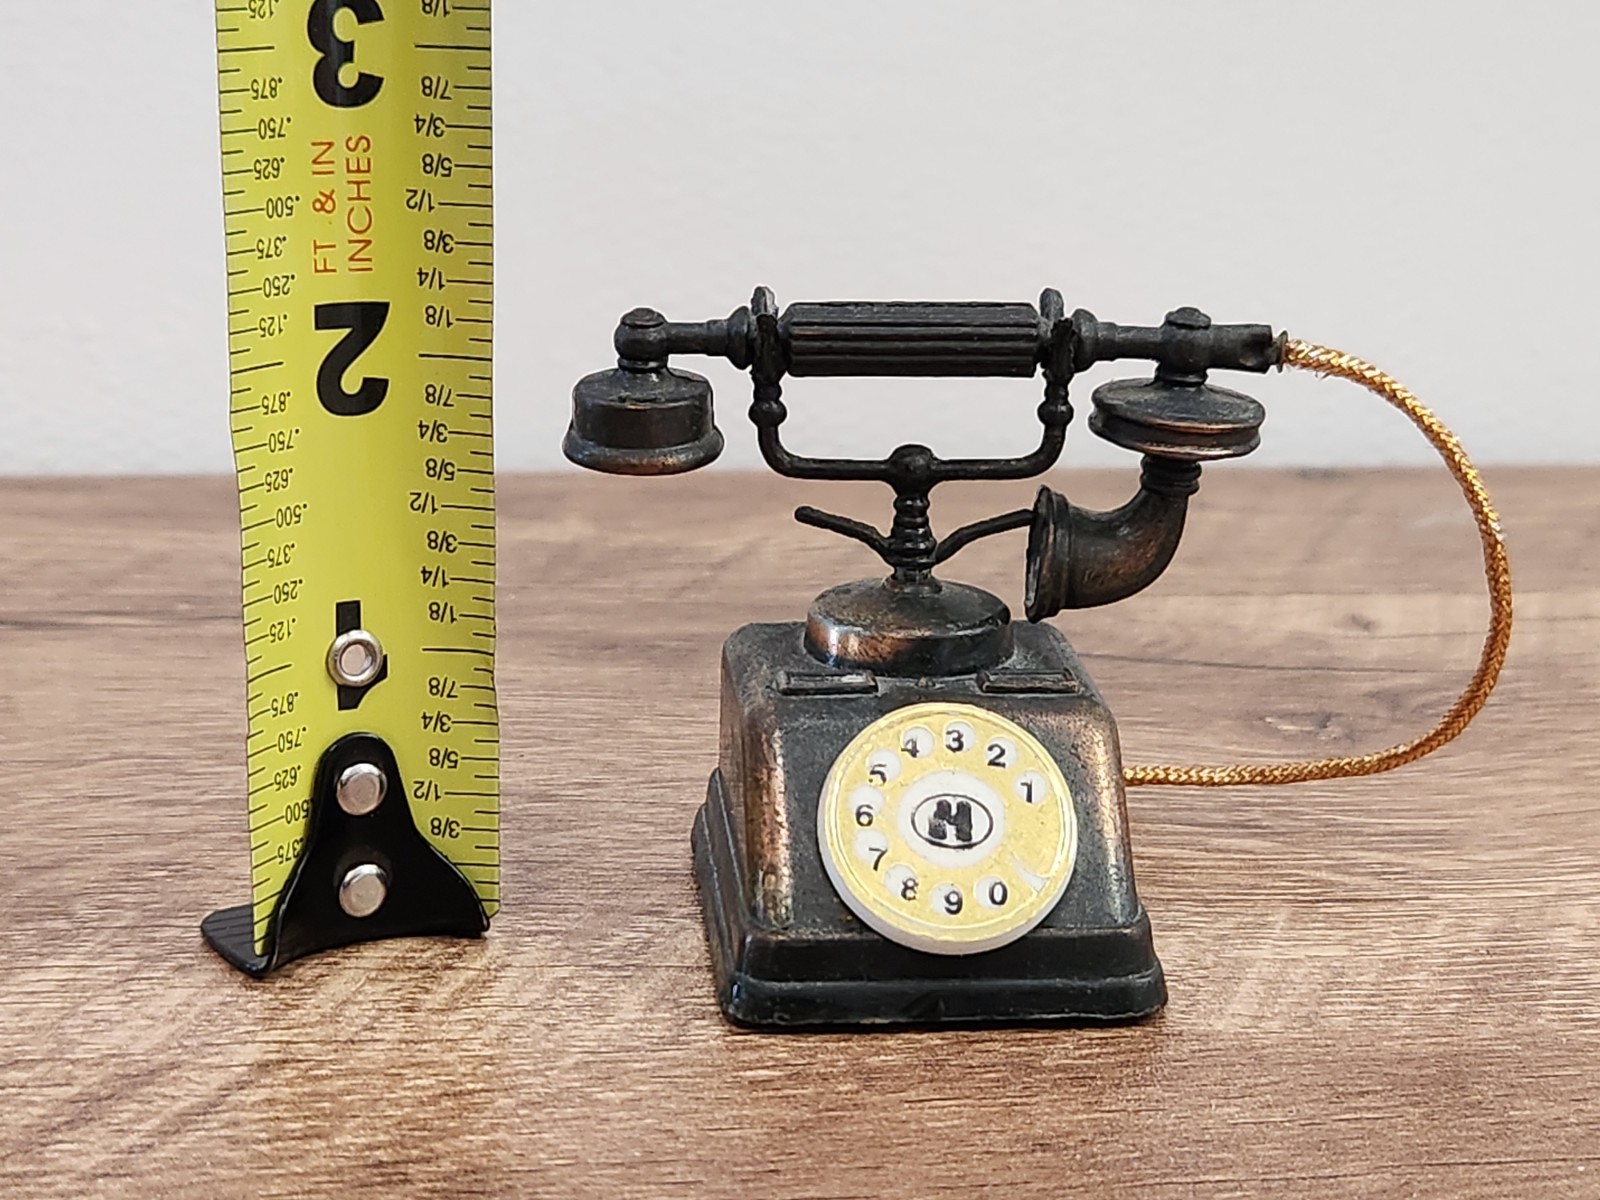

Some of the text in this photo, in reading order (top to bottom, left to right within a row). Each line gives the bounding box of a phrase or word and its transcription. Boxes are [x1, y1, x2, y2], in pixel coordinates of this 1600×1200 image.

[307, 0, 385, 108] 3
[251, 77, 282, 100] .875
[421, 76, 452, 100] 7/8
[258, 117, 291, 139] .750
[414, 114, 445, 137] 3/4
[254, 158, 285, 180] .625
[422, 153, 452, 177] 5/8
[266, 196, 300, 219] .500
[311, 141, 337, 273] FT & IN
[346, 135, 373, 272] INCHES
[405, 189, 434, 212] 1/2
[257, 236, 287, 259] .375
[424, 230, 454, 254] 3/8
[263, 274, 295, 298] .250
[417, 267, 445, 290] 1/4
[259, 314, 287, 337] .125
[425, 305, 453, 328] 1/8
[314, 301, 390, 417] 2
[261, 392, 291, 415] .875
[425, 384, 454, 407] 7/8
[268, 429, 300, 453] .750
[418, 420, 448, 443] 3/4
[265, 468, 293, 493] .625
[425, 458, 455, 481] 5/8
[410, 492, 438, 514] 1/2
[276, 503, 307, 528] .500
[427, 531, 458, 553] 3/8
[267, 543, 295, 568] .375
[421, 566, 449, 587] 1/4
[274, 579, 303, 604] .250
[428, 602, 457, 624] 1/8
[269, 618, 296, 643] .125
[428, 677, 458, 698] 7/8
[271, 692, 299, 718] .875
[421, 711, 451, 733] 3/4
[278, 727, 307, 752] .750
[900, 737, 919, 758] 4
[945, 729, 964, 753] 3
[429, 748, 458, 768] 5/8
[988, 743, 1007, 768] 2
[274, 765, 301, 791] .625
[868, 763, 887, 785] 5
[413, 780, 441, 801] 1/2
[1020, 779, 1033, 804] 1
[855, 804, 874, 827] 6
[430, 817, 460, 839] 3/8
[868, 847, 888, 872] 7
[900, 878, 919, 901] 8
[989, 881, 1008, 906] 0
[943, 890, 963, 915] 9
